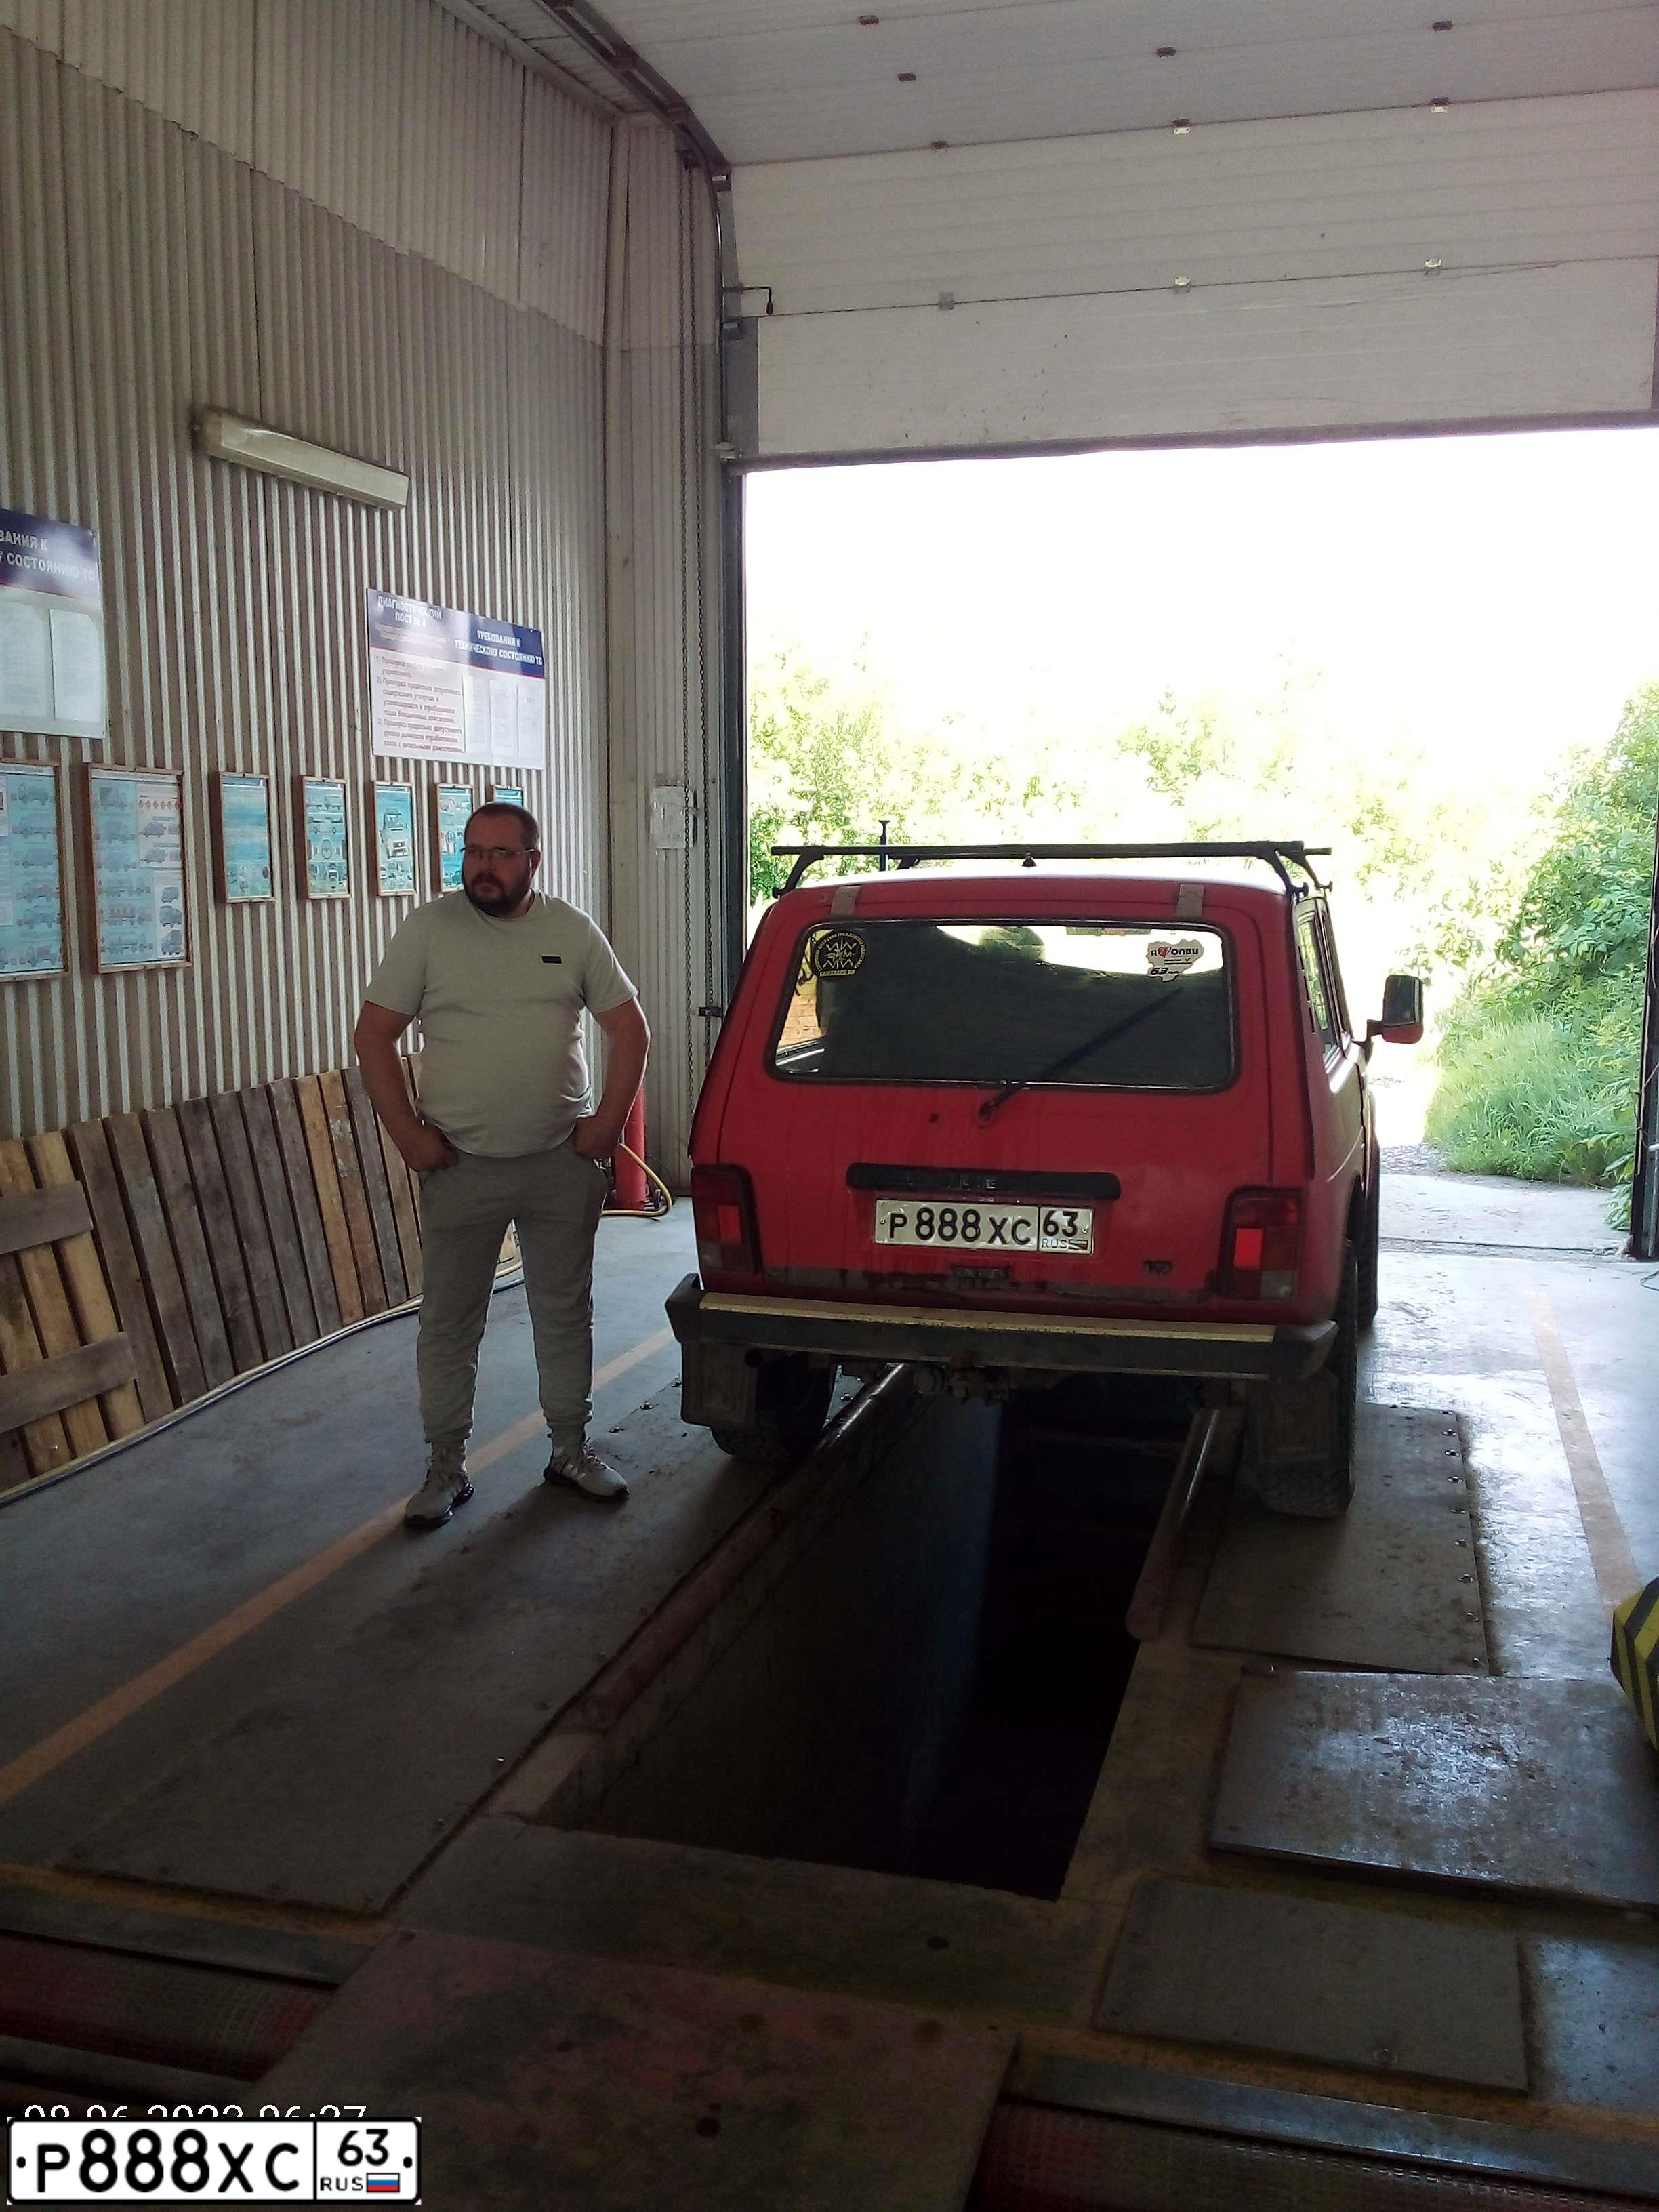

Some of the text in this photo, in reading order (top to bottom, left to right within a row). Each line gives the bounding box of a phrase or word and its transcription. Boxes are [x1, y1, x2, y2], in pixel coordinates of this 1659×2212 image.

[41, 538, 48, 551] К
[477, 630, 516, 647] ТРЕБОВАНИЯ
[499, 649, 535, 664] СОСТОЯНИЮ
[1042, 1210, 1079, 1237] 63
[1041, 1238, 1068, 1250] RUS
